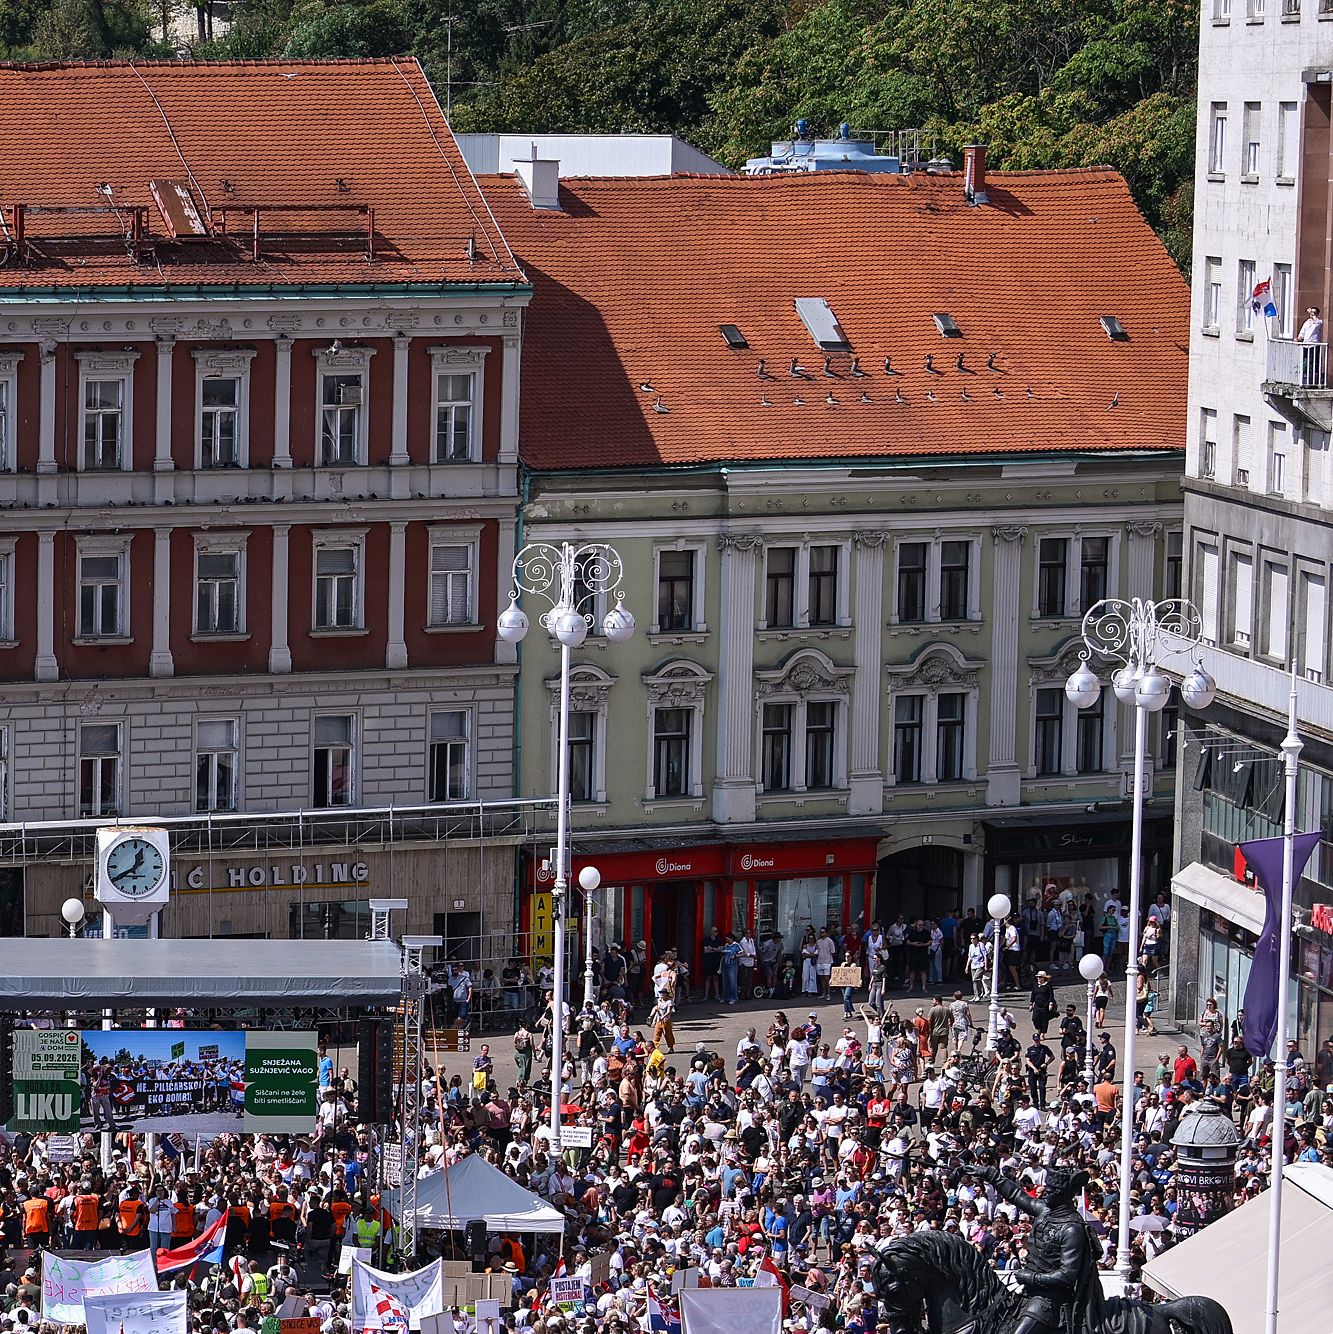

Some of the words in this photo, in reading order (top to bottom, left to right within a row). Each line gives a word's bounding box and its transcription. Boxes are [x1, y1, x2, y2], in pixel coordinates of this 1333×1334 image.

[669, 862, 692, 872] Diona
[754, 857, 774, 868] Diona
[228, 861, 369, 888] HOLDING
[535, 897, 548, 949] ATM
[38, 1031, 65, 1039] GOSPIĆ
[49, 1038, 65, 1046] NAŠ
[31, 1053, 80, 1064] 05.09.2026.
[262, 1057, 301, 1066] SNJEŽANA
[249, 1065, 289, 1075] SUŽNJEVIĆ
[290, 1066, 314, 1074] VAGO
[17, 1093, 73, 1121] LIKU
[554, 1278, 581, 1293] POSTAJEM
